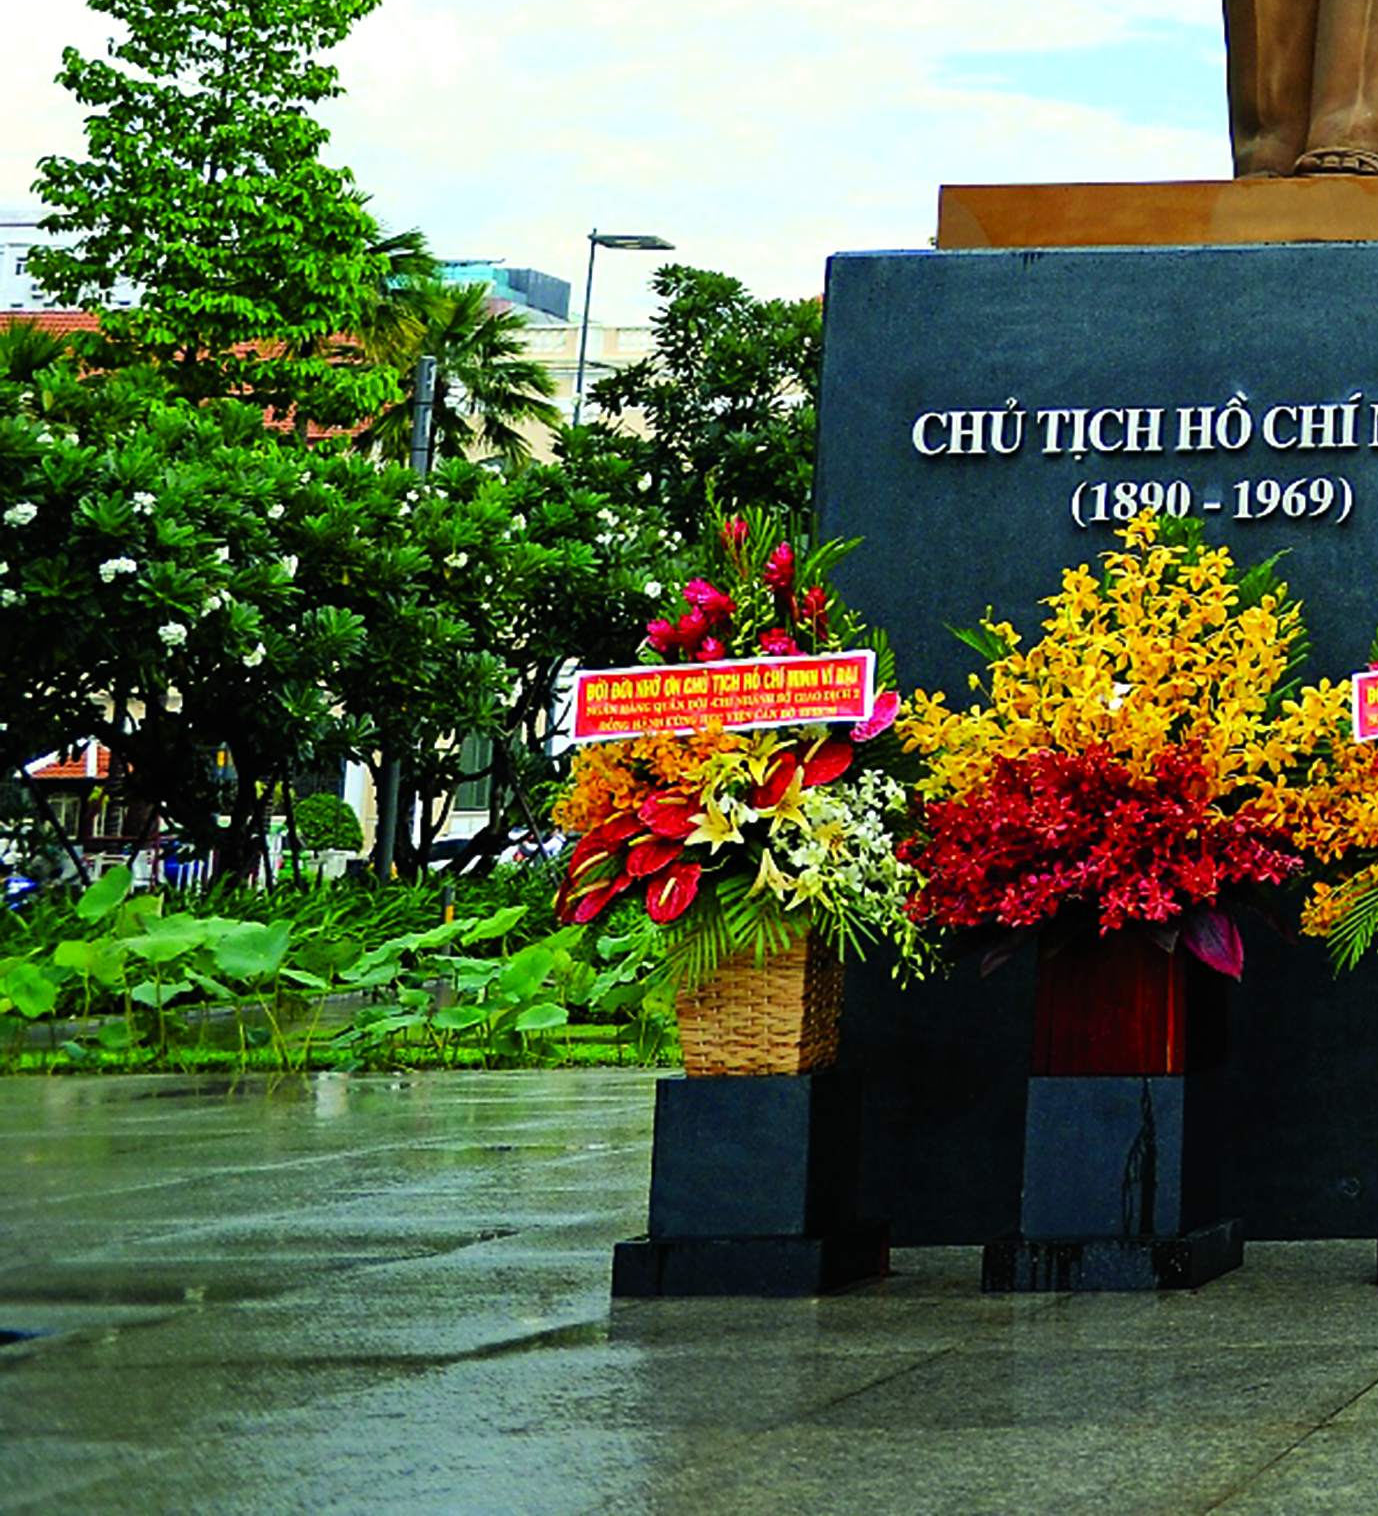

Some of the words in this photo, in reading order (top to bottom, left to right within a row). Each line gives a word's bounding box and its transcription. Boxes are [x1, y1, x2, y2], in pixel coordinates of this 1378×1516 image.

[911, 398, 1024, 455] CHỦ
[1037, 407, 1163, 460] TỊCH
[1175, 390, 1253, 450] HỒ
[1262, 392, 1362, 449] CHÍ
[1071, 480, 1191, 527] (1890
[1232, 476, 1353, 523] 1969)
[712, 674, 741, 695] TỊCH
[764, 667, 785, 689] CHÍ
